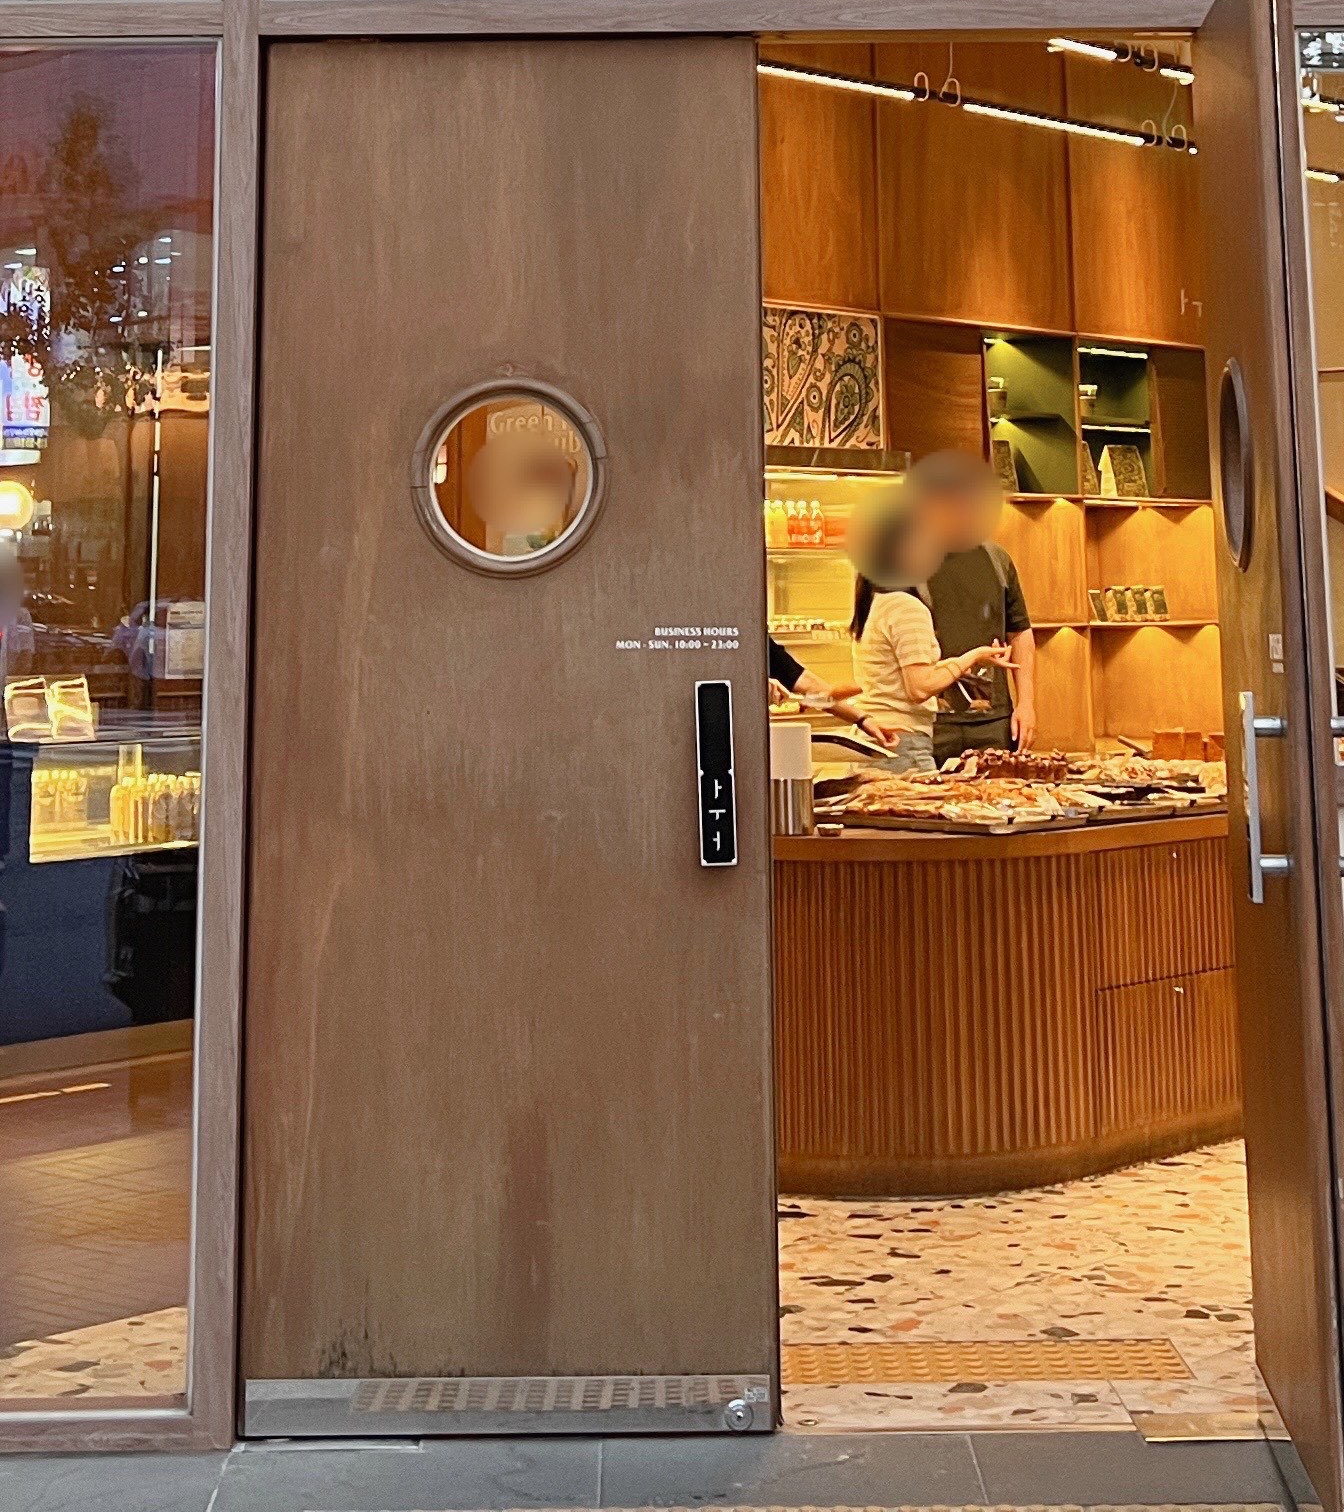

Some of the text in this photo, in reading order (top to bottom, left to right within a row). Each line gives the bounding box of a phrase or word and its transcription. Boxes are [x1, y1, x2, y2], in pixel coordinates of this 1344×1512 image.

[654, 627, 739, 637] BUSINESS HOURS
[615, 640, 641, 649] MON
[674, 640, 701, 649] 10:00
